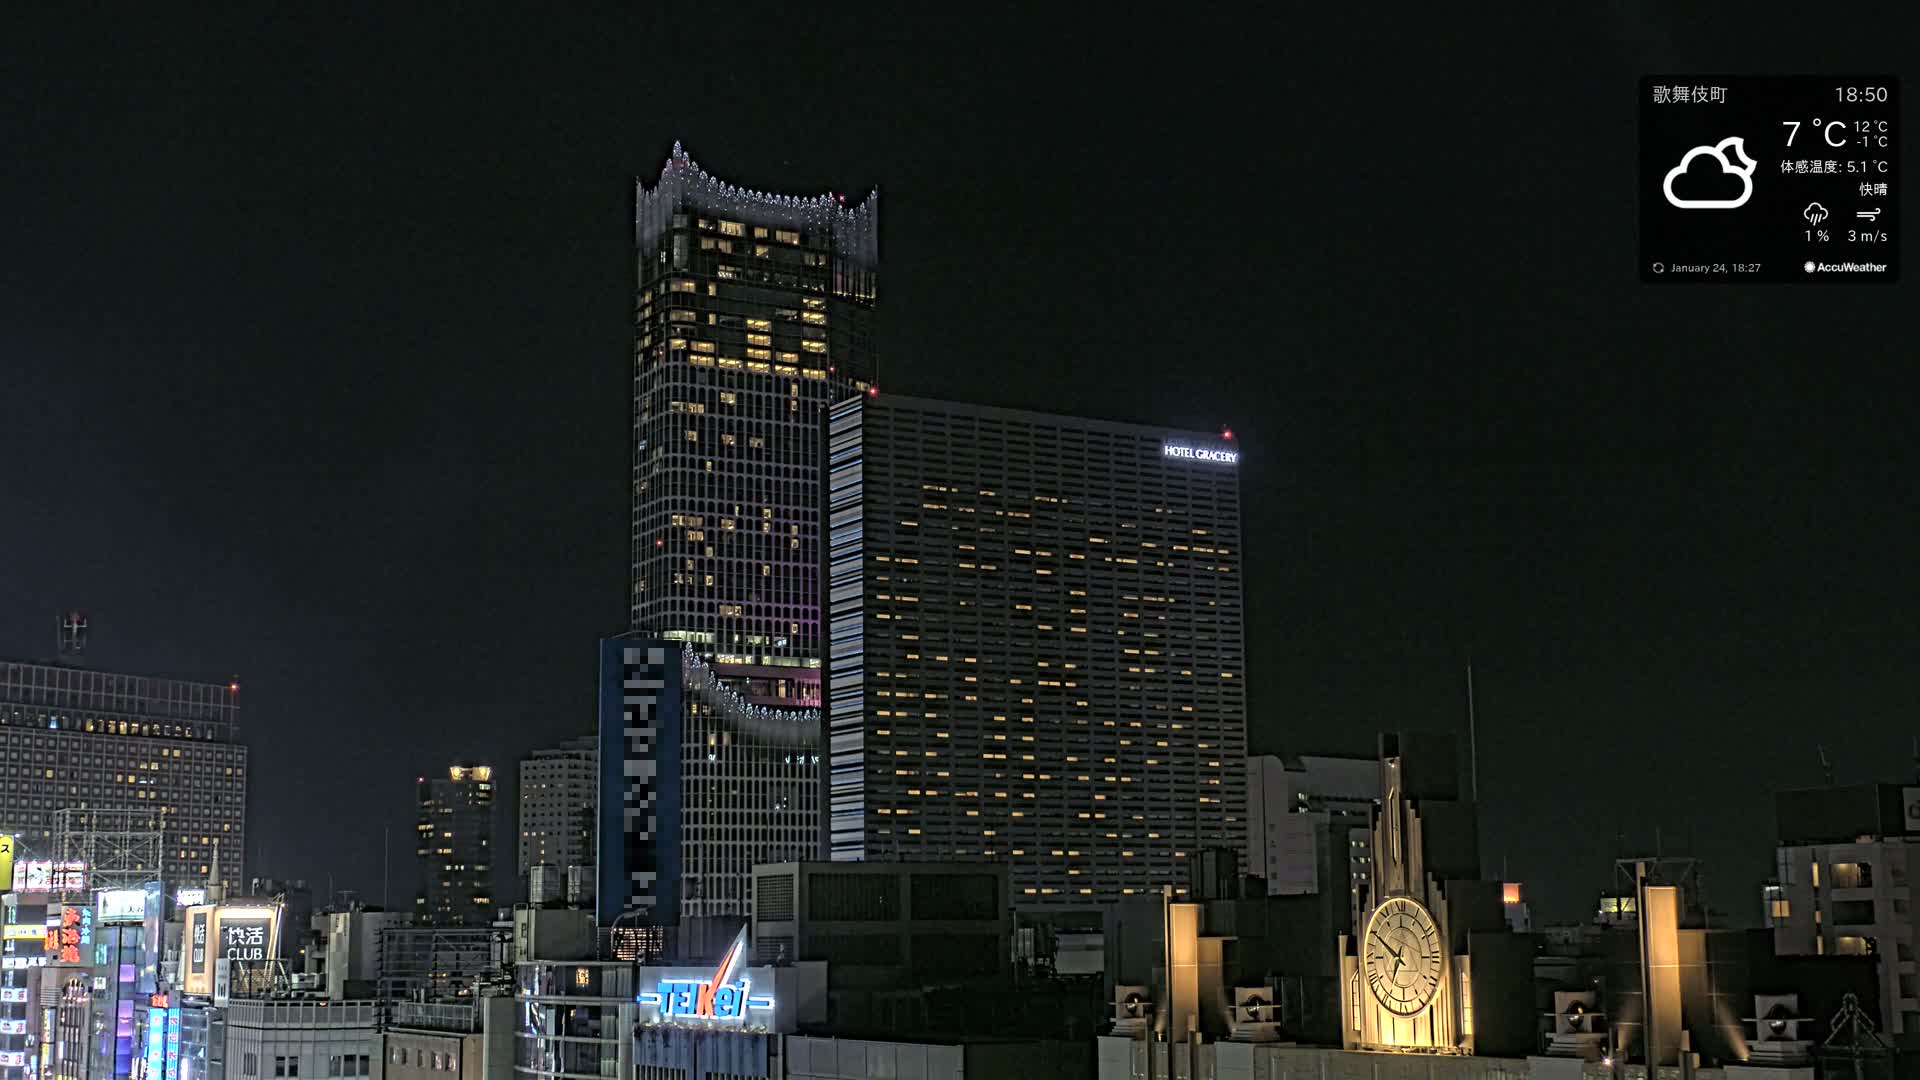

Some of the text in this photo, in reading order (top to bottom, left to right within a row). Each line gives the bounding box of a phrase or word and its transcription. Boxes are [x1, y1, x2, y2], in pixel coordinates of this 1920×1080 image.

[1164, 445, 1237, 462] HOTEL GRACERY
[228, 926, 264, 945] 快活
[227, 947, 263, 961] CLUB
